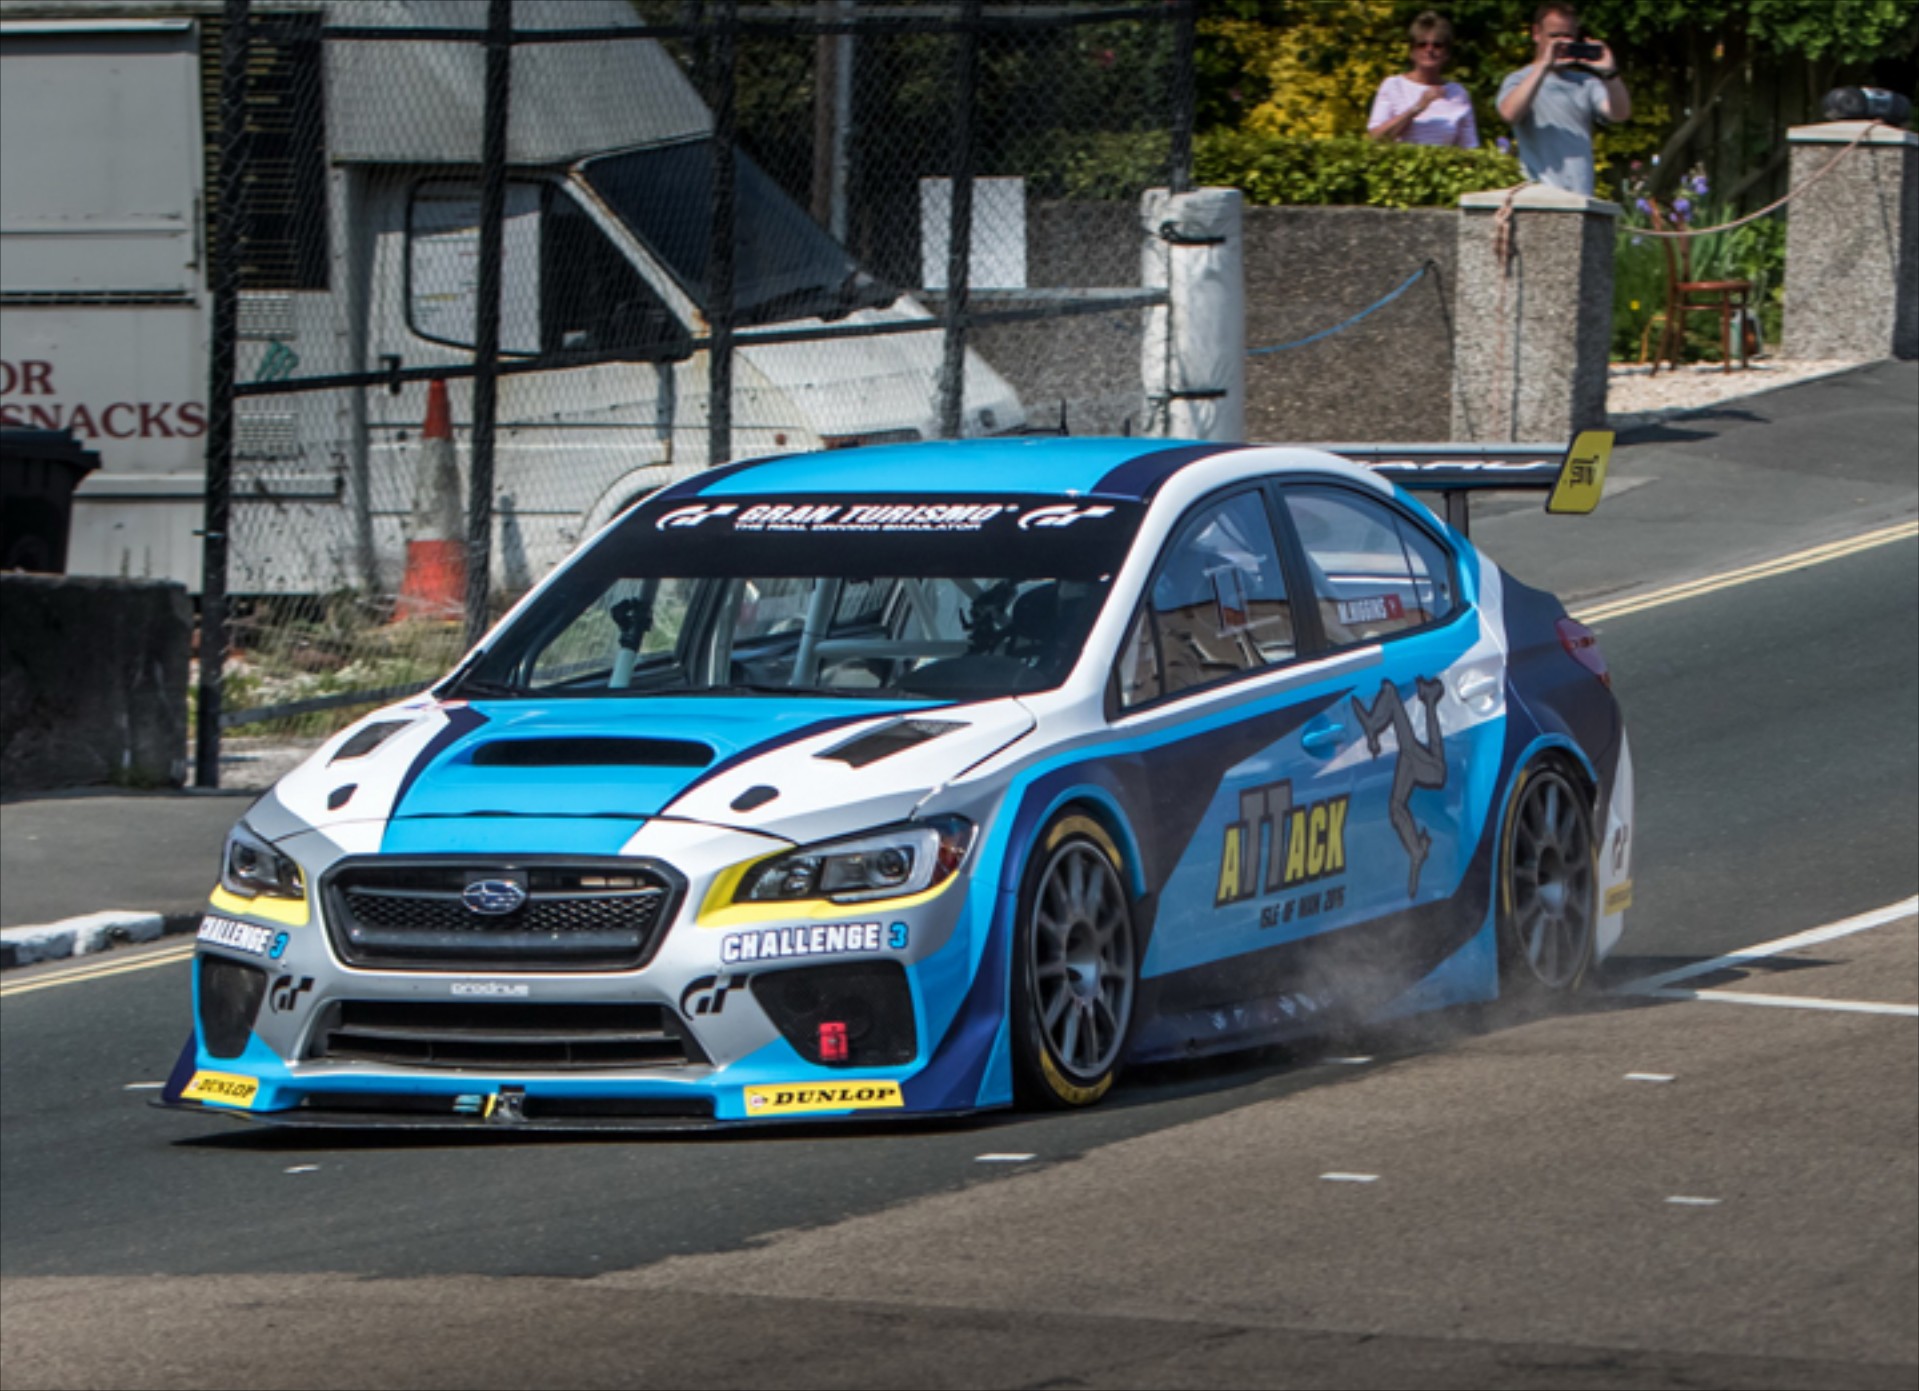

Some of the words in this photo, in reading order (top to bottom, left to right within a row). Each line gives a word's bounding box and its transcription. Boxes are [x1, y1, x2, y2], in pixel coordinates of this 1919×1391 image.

[737, 503, 842, 523] GRAN
[196, 913, 274, 957] CHALLENGE
[269, 929, 289, 959] 3
[722, 922, 881, 964] CHALLENGE
[888, 921, 908, 949] 3
[772, 1087, 897, 1107] DUNLOP
